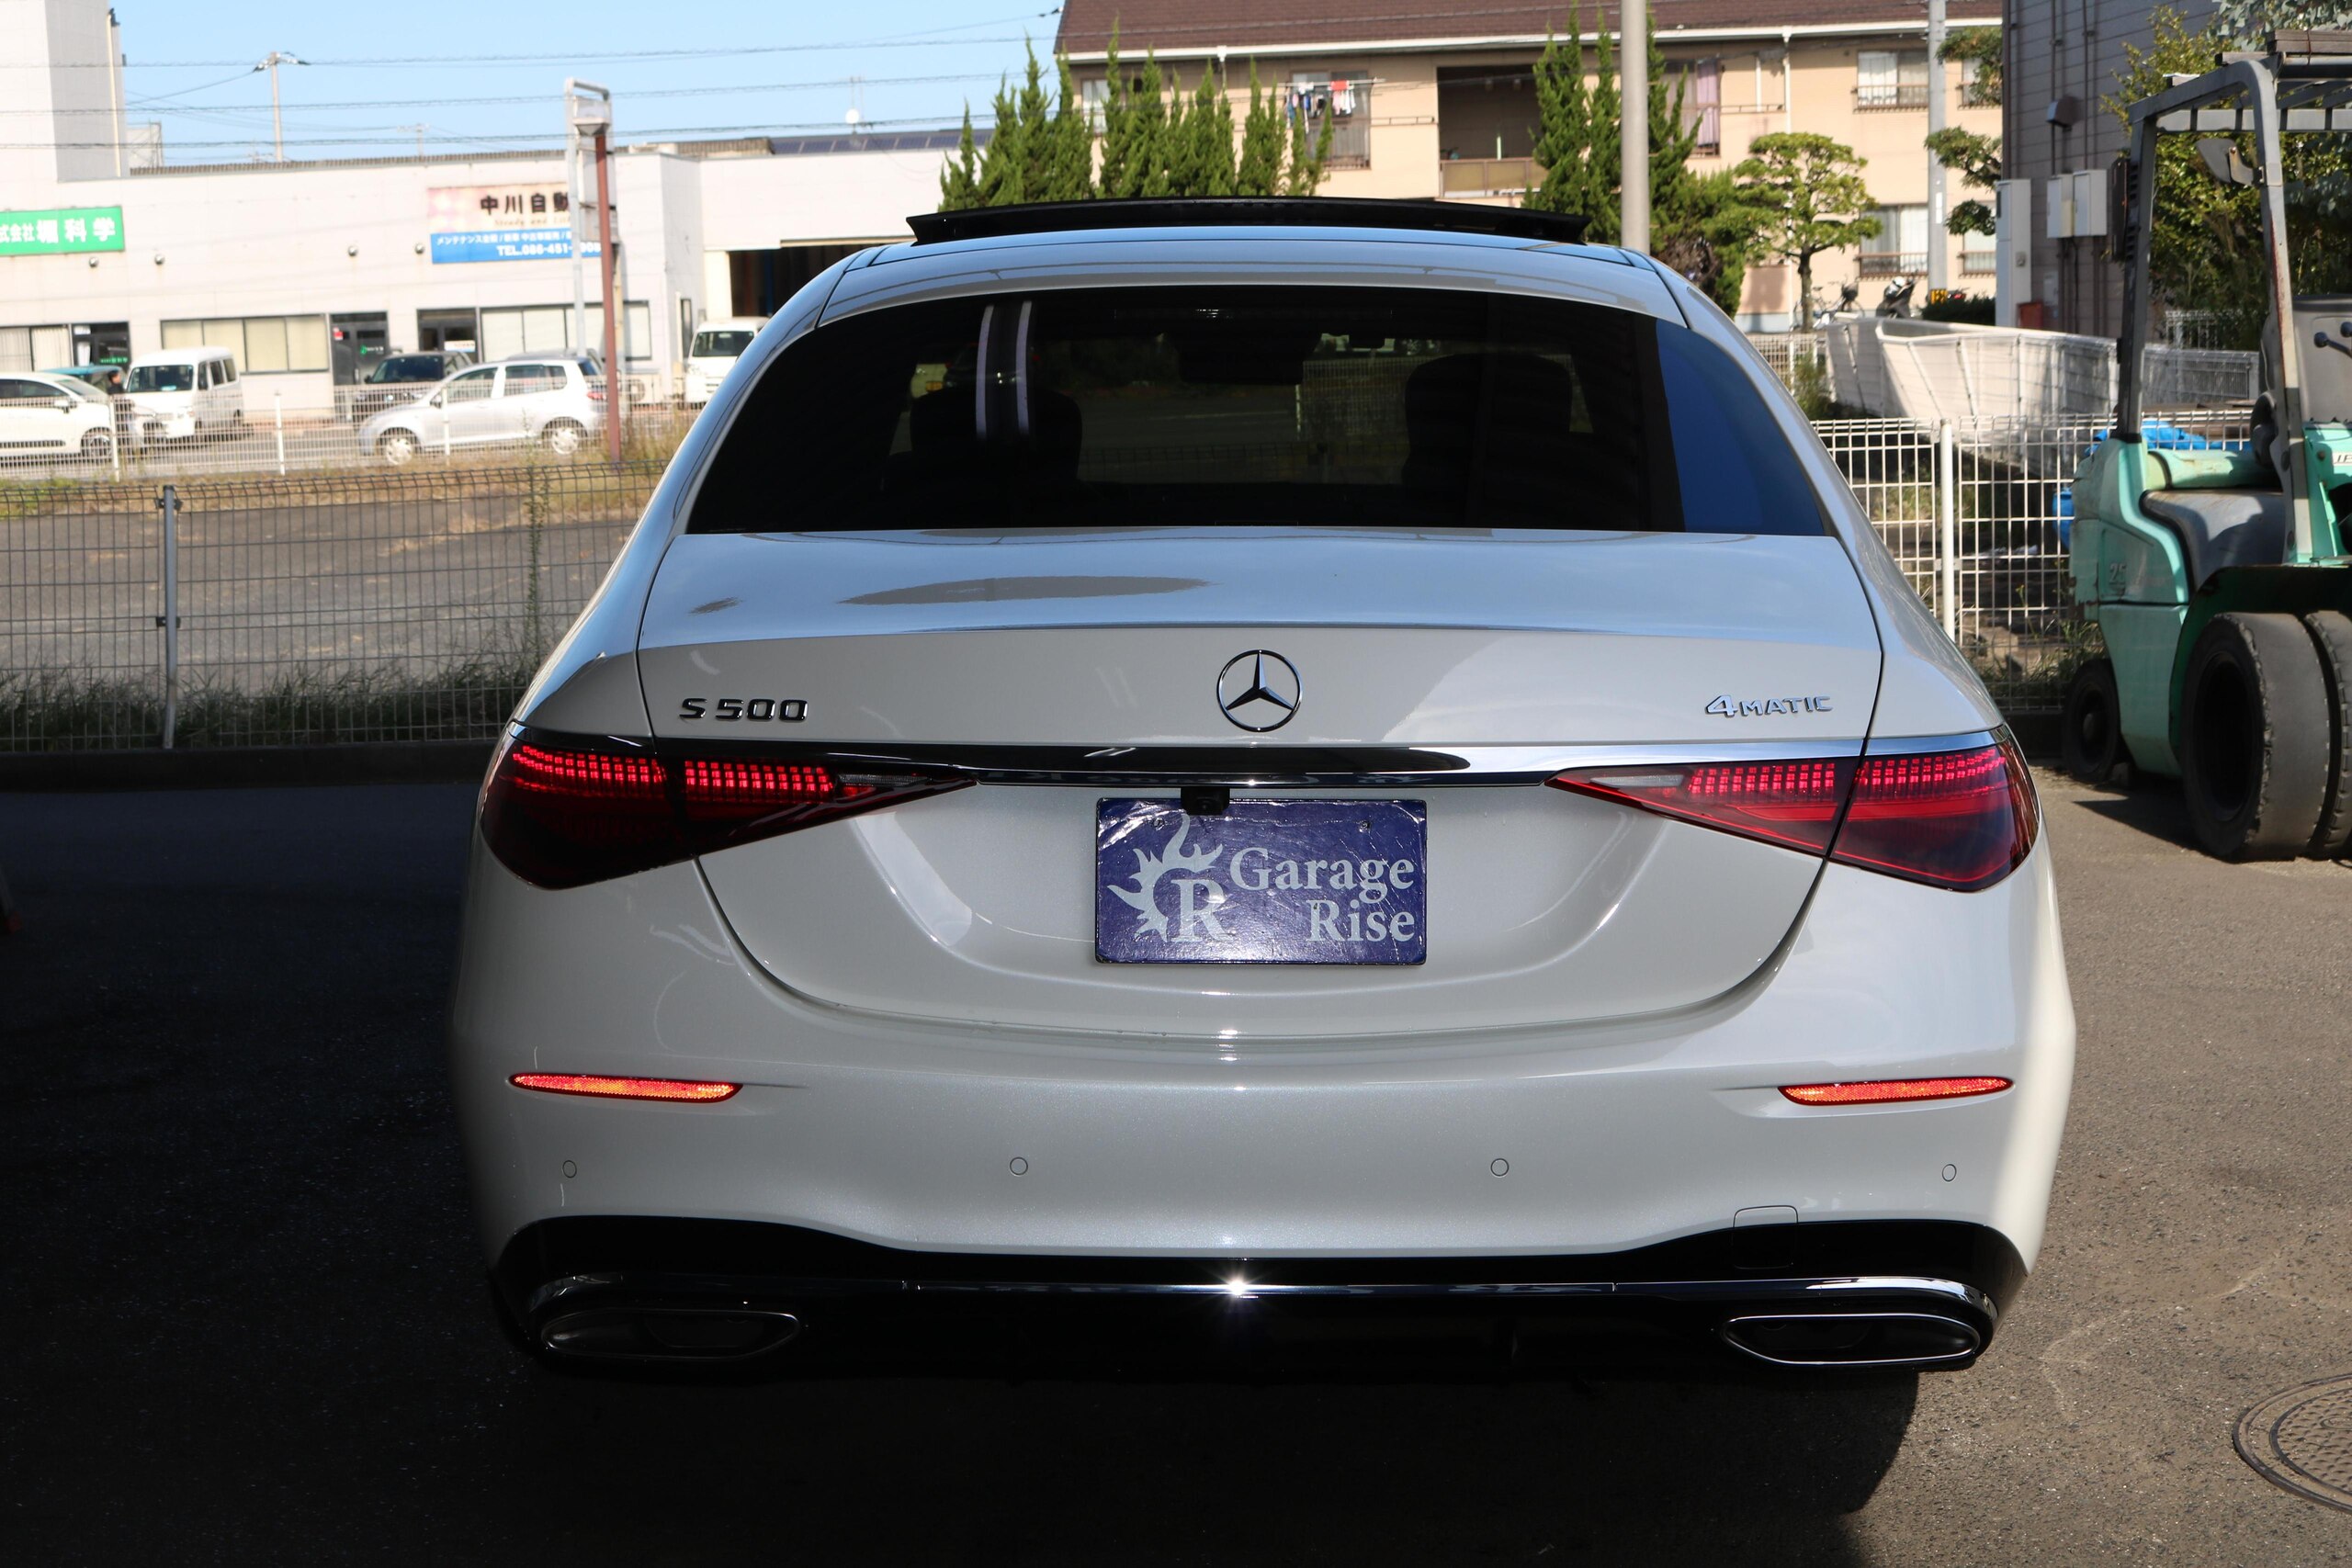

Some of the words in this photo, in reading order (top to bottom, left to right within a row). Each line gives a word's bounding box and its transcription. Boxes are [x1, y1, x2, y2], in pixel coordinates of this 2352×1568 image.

[679, 698, 707, 719] S
[715, 698, 808, 721] 500
[1705, 694, 1834, 718] 4MATIC
[1229, 846, 1415, 904] Garage
[1170, 878, 1232, 942] R
[1305, 898, 1416, 942] Rise
